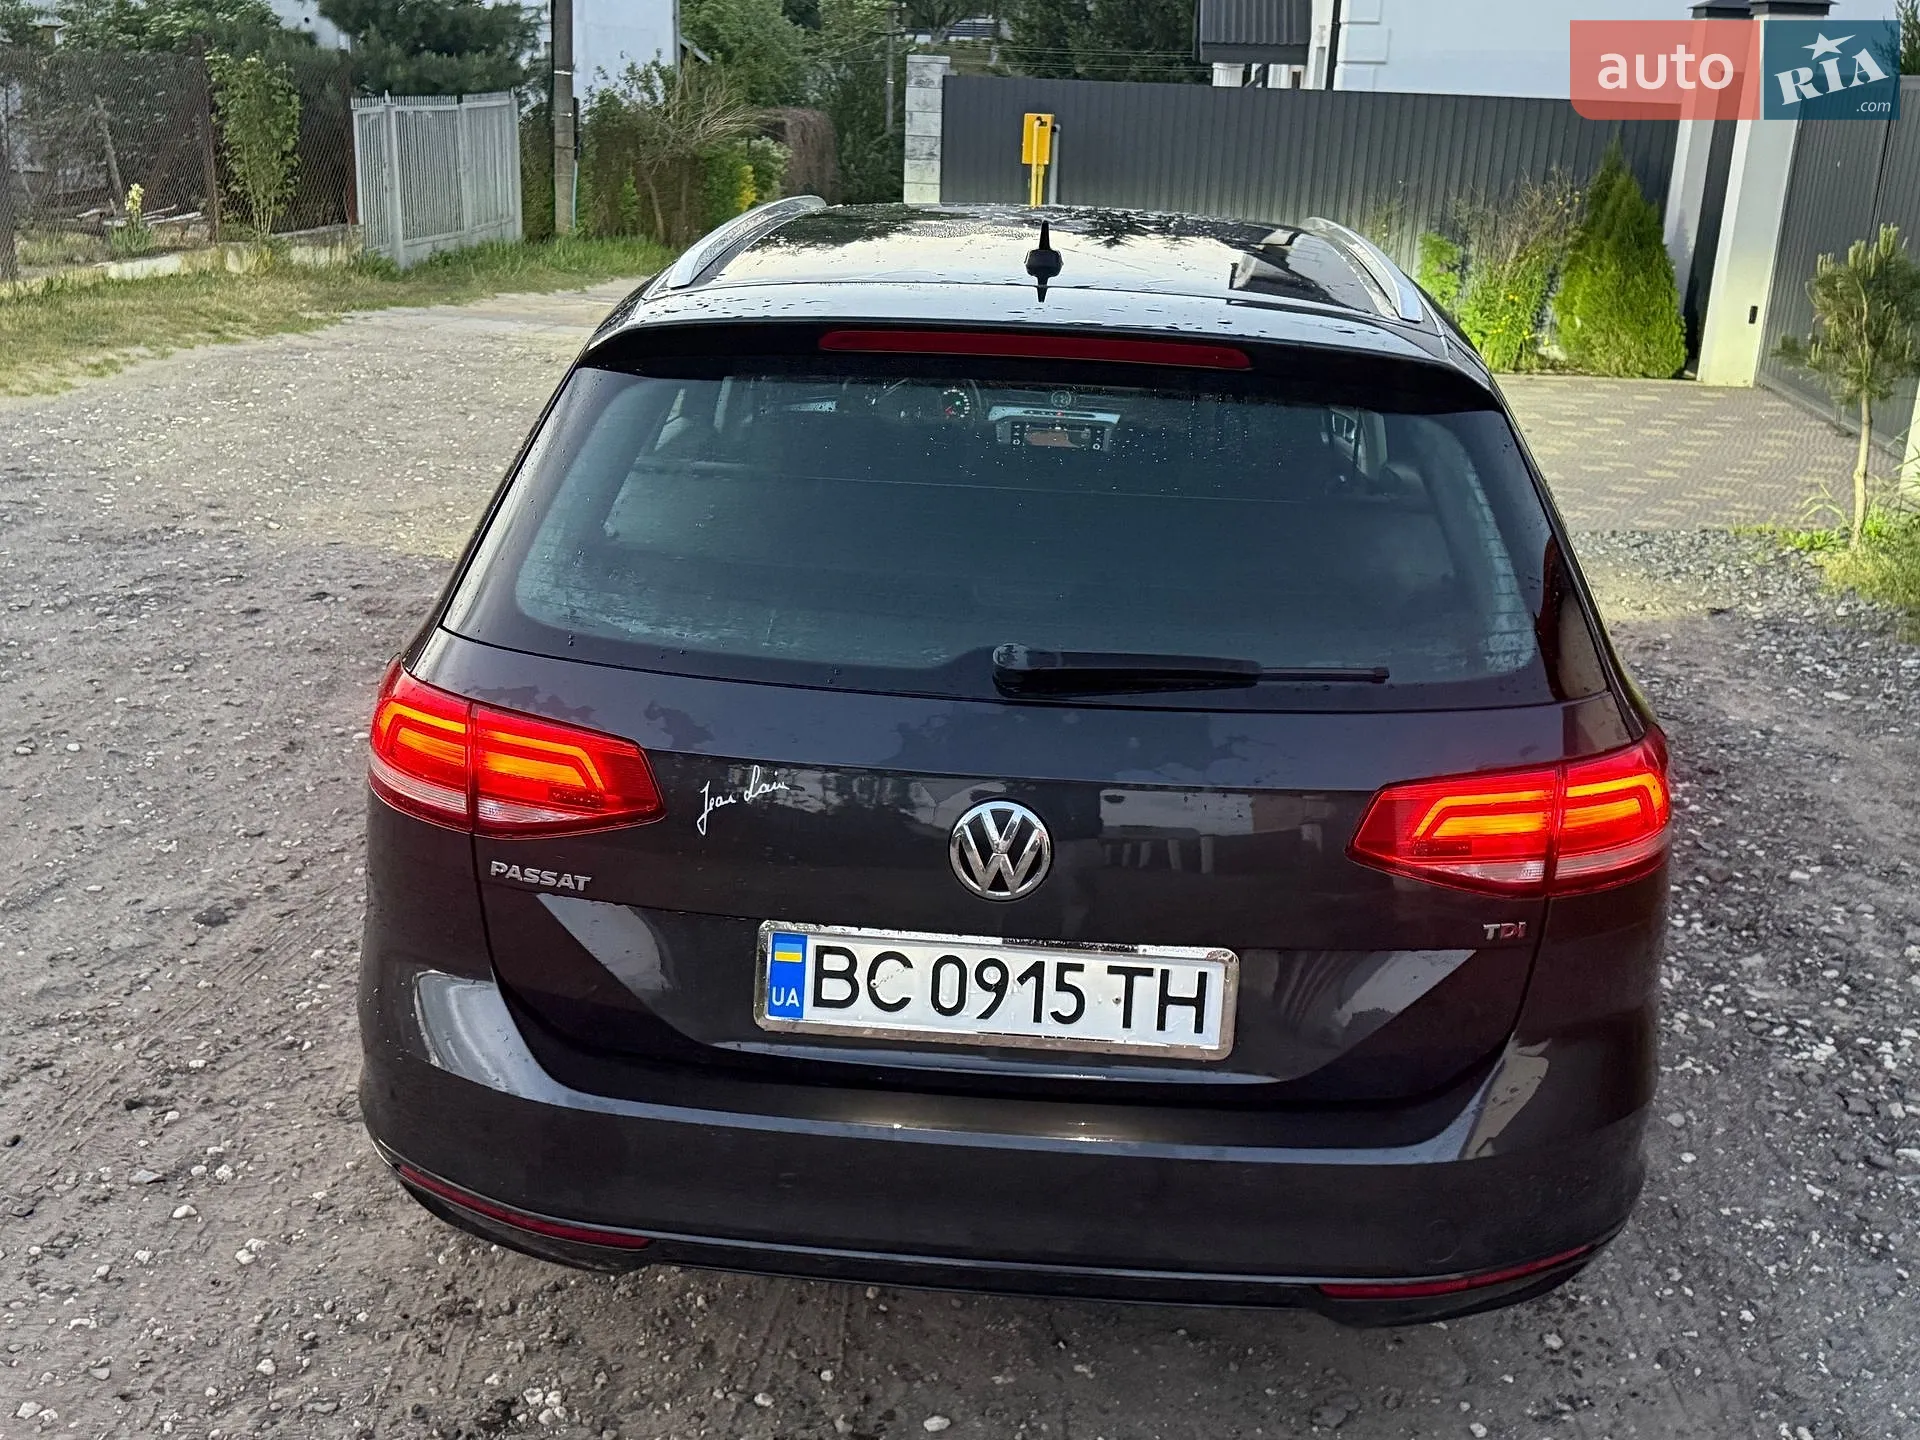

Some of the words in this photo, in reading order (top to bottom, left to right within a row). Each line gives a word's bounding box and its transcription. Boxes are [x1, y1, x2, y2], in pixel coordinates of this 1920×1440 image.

[490, 860, 592, 892] PASSAT
[1483, 921, 1527, 940] TDI
[771, 987, 801, 1008] UA
[812, 945, 914, 1013] BC
[930, 954, 1088, 1026] 0915
[1106, 964, 1208, 1035] TH
